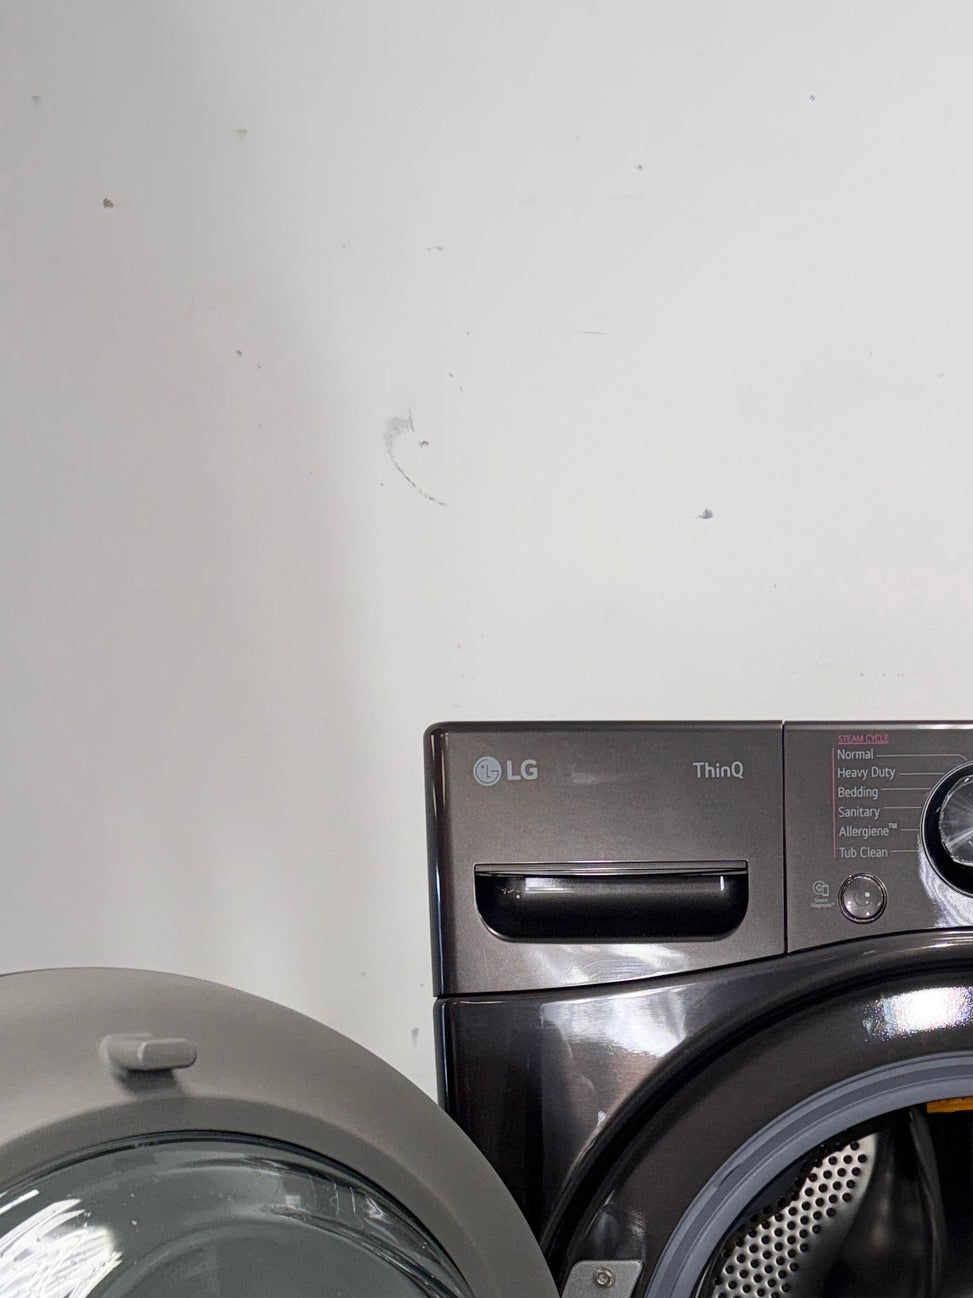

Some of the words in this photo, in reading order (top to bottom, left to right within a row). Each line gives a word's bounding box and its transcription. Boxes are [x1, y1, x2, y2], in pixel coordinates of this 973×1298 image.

[839, 735, 863, 743] STEAM
[865, 735, 888, 743] CYCLE
[838, 749, 873, 760] Normal
[507, 760, 538, 780] LG
[693, 762, 743, 779] ThinQ
[838, 767, 868, 779] Heavy
[871, 767, 895, 779] Duty
[838, 787, 878, 800] Bedding
[839, 806, 880, 819] Sanitary
[840, 847, 856, 857] Tub
[859, 847, 888, 857] Clean
